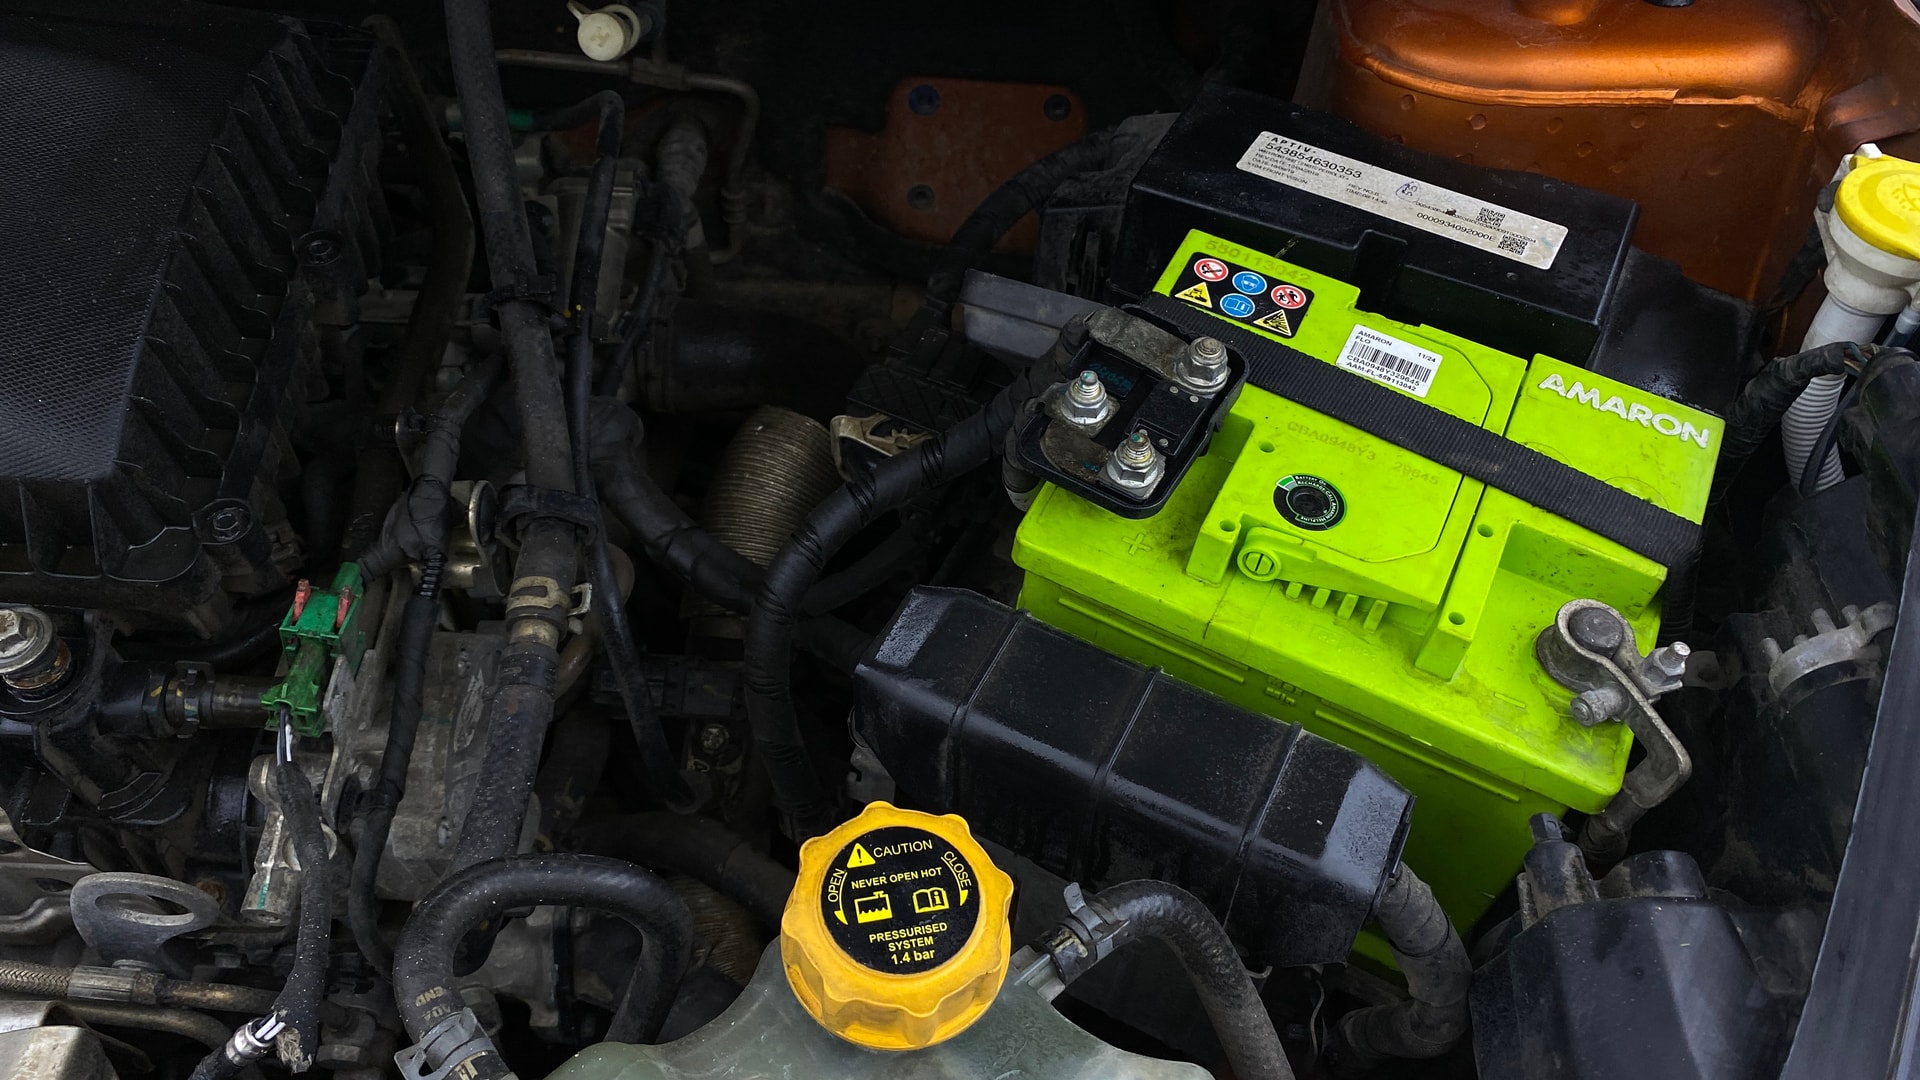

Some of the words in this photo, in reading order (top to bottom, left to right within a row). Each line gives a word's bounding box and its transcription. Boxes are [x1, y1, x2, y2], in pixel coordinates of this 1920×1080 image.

[1270, 137, 1312, 153] APTIV
[1265, 143, 1362, 179] 543854630353
[1205, 240, 1312, 283] 550113042
[1355, 335, 1371, 345] FLO
[1358, 331, 1393, 346] AMARON
[1418, 352, 1437, 363] 11/24
[1346, 355, 1420, 386] CBA0948Y329645
[1539, 373, 1710, 448] AMARON
[873, 839, 933, 858] CAUTION
[851, 876, 887, 890] NEVER
[889, 871, 919, 882] OPEN
[921, 867, 942, 877] HOT
[943, 851, 972, 887] CLOSE
[828, 868, 845, 902] OPEN
[869, 922, 948, 943] PRESSURISED
[888, 936, 934, 952] SYSTEM
[891, 953, 911, 965] 1.4
[914, 949, 935, 961] bar
